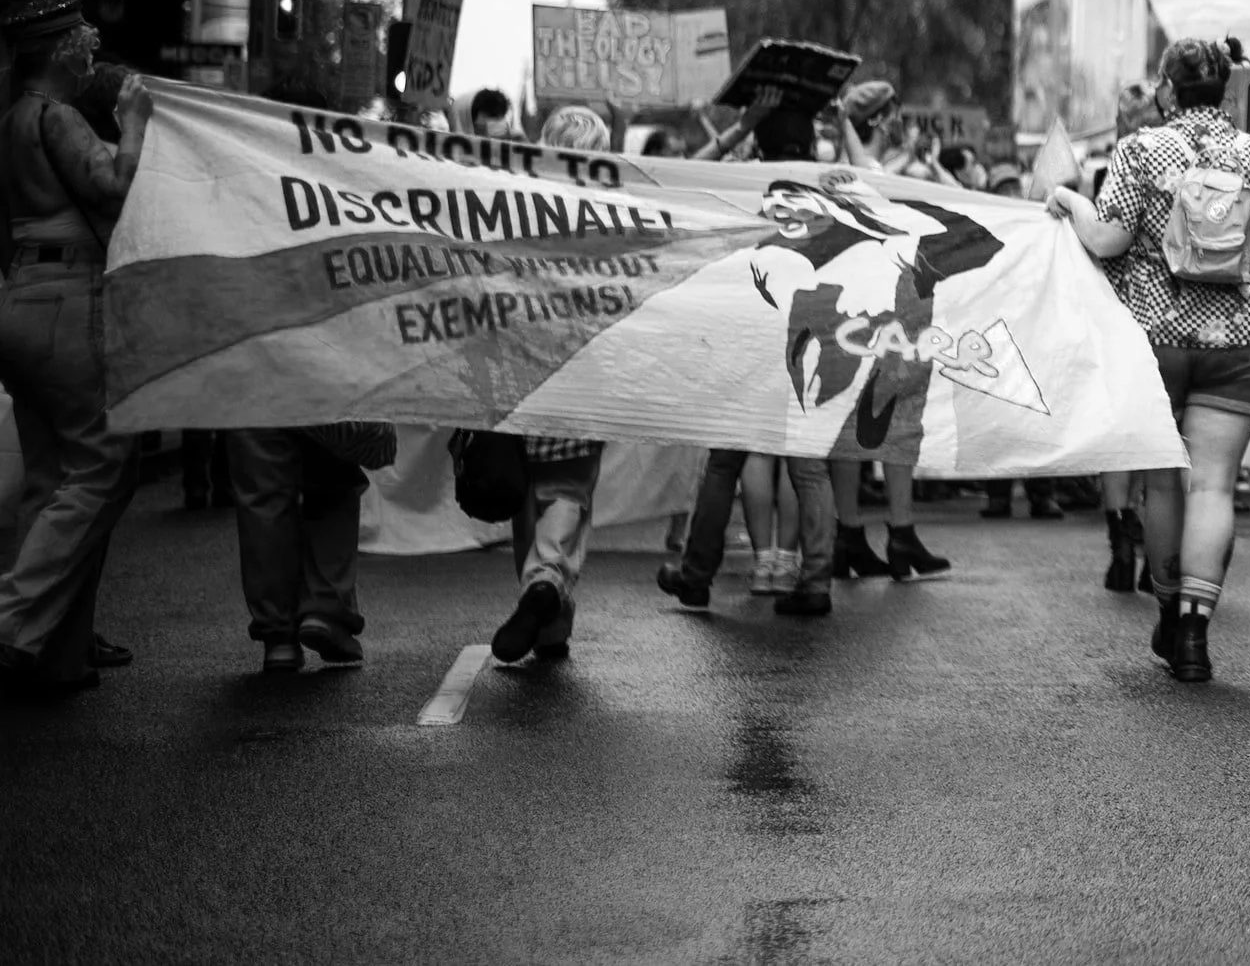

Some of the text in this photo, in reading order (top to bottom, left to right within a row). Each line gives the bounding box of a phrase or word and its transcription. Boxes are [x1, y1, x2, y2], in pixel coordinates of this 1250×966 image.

[536, 26, 671, 67] THEOLOGY
[576, 10, 651, 38] BAD
[291, 111, 372, 154] NO
[557, 151, 624, 188] TO
[322, 242, 494, 291] EQUALITY
[395, 284, 635, 345] EXEMPTIONS!
